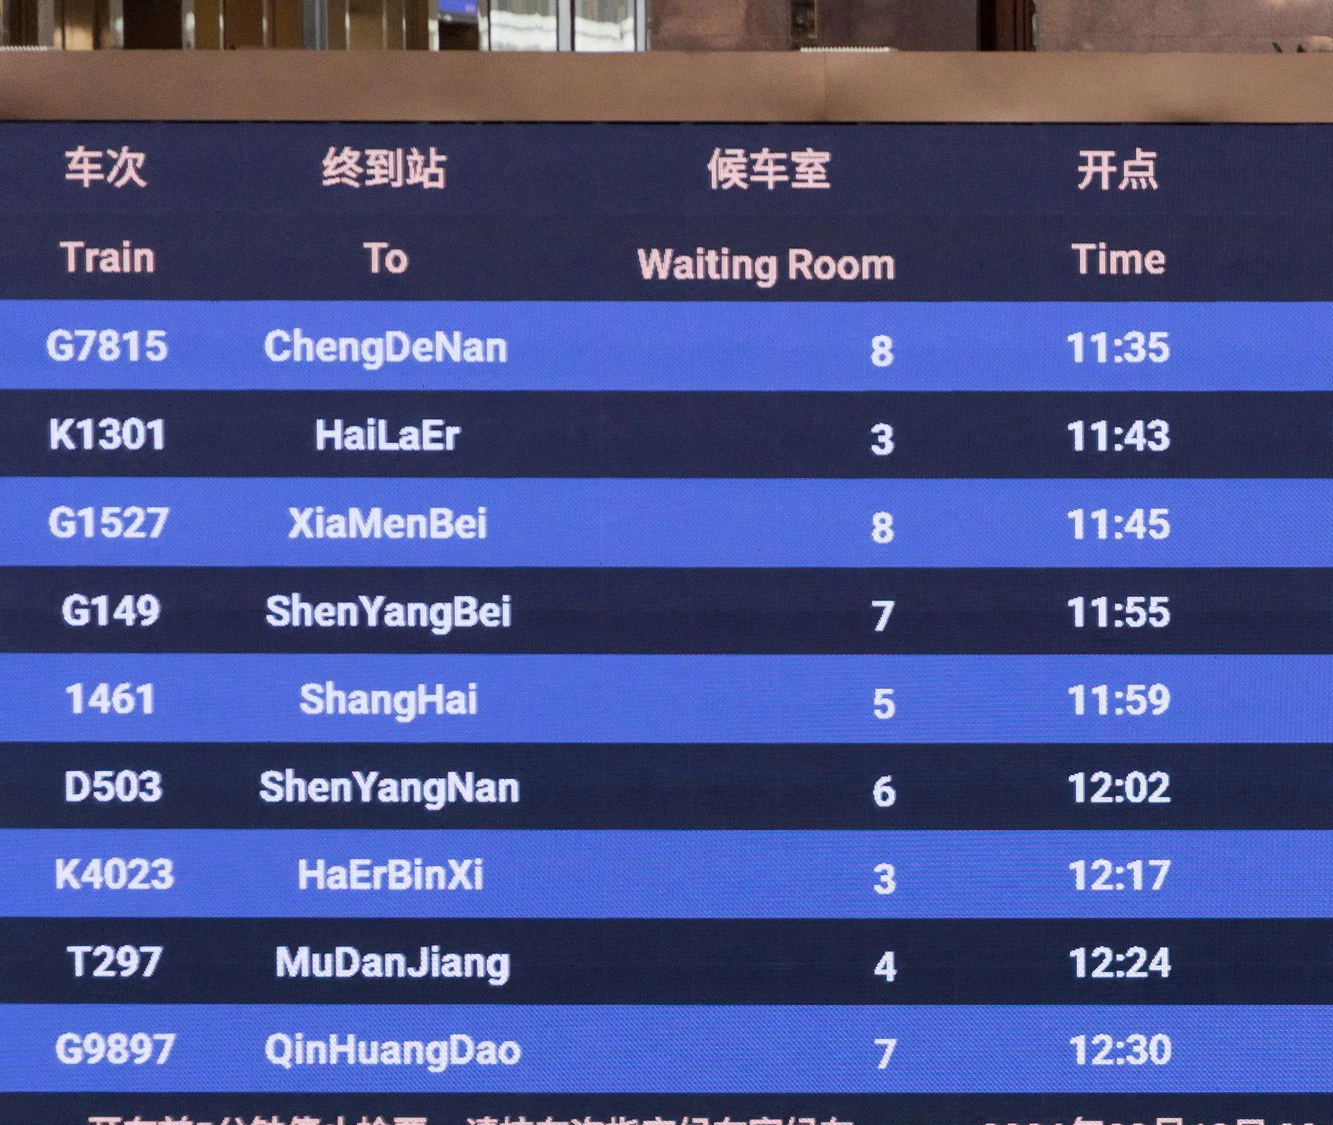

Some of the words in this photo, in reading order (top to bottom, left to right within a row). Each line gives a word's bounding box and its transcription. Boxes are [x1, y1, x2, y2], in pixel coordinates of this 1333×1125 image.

[67, 147, 147, 188] 车次
[324, 148, 447, 189] 终到站
[709, 149, 831, 190] 候车室
[1079, 149, 1158, 190] 开点
[61, 242, 154, 273] Train
[364, 243, 408, 274] To
[639, 248, 777, 289] Waiting
[790, 250, 895, 280] Room
[1073, 243, 1166, 275] Time
[48, 330, 168, 362] G7815
[266, 329, 507, 371] ChengDeNan
[872, 336, 894, 368] 8
[1069, 332, 1170, 364] 11:35
[52, 419, 163, 450] K1301
[318, 419, 461, 451] HaiLaEr
[872, 424, 894, 456] 3
[1069, 420, 1170, 452] 11:43
[50, 507, 170, 539] G1527
[290, 507, 487, 540] XiaMenBei
[873, 513, 895, 544] 8
[1069, 509, 1171, 540] 11:45
[64, 595, 160, 627] G149
[268, 594, 510, 635] ShenYangBei
[873, 602, 895, 632] 7
[1069, 598, 1170, 628] 11:55
[67, 684, 154, 715] 1461
[301, 682, 477, 723] ShangHai
[875, 690, 896, 720] 5
[1070, 684, 1171, 716] 11:59
[67, 771, 162, 802] D503
[261, 770, 519, 811] ShenYangNan
[874, 777, 896, 807] 6
[1070, 772, 1171, 803] 12:02
[57, 859, 175, 890] K4023
[300, 859, 484, 891] HaErBinXi
[875, 864, 897, 895] 3
[1070, 860, 1171, 891] 12:17
[68, 946, 163, 977] T297
[278, 947, 510, 986] MuDanJiang
[876, 953, 897, 982] 4
[1071, 947, 1171, 978] 12:24
[57, 1034, 176, 1065] G9897
[266, 1034, 522, 1073] QinHuangDao
[876, 1040, 897, 1070] 7
[1071, 1035, 1172, 1066] 12:30
